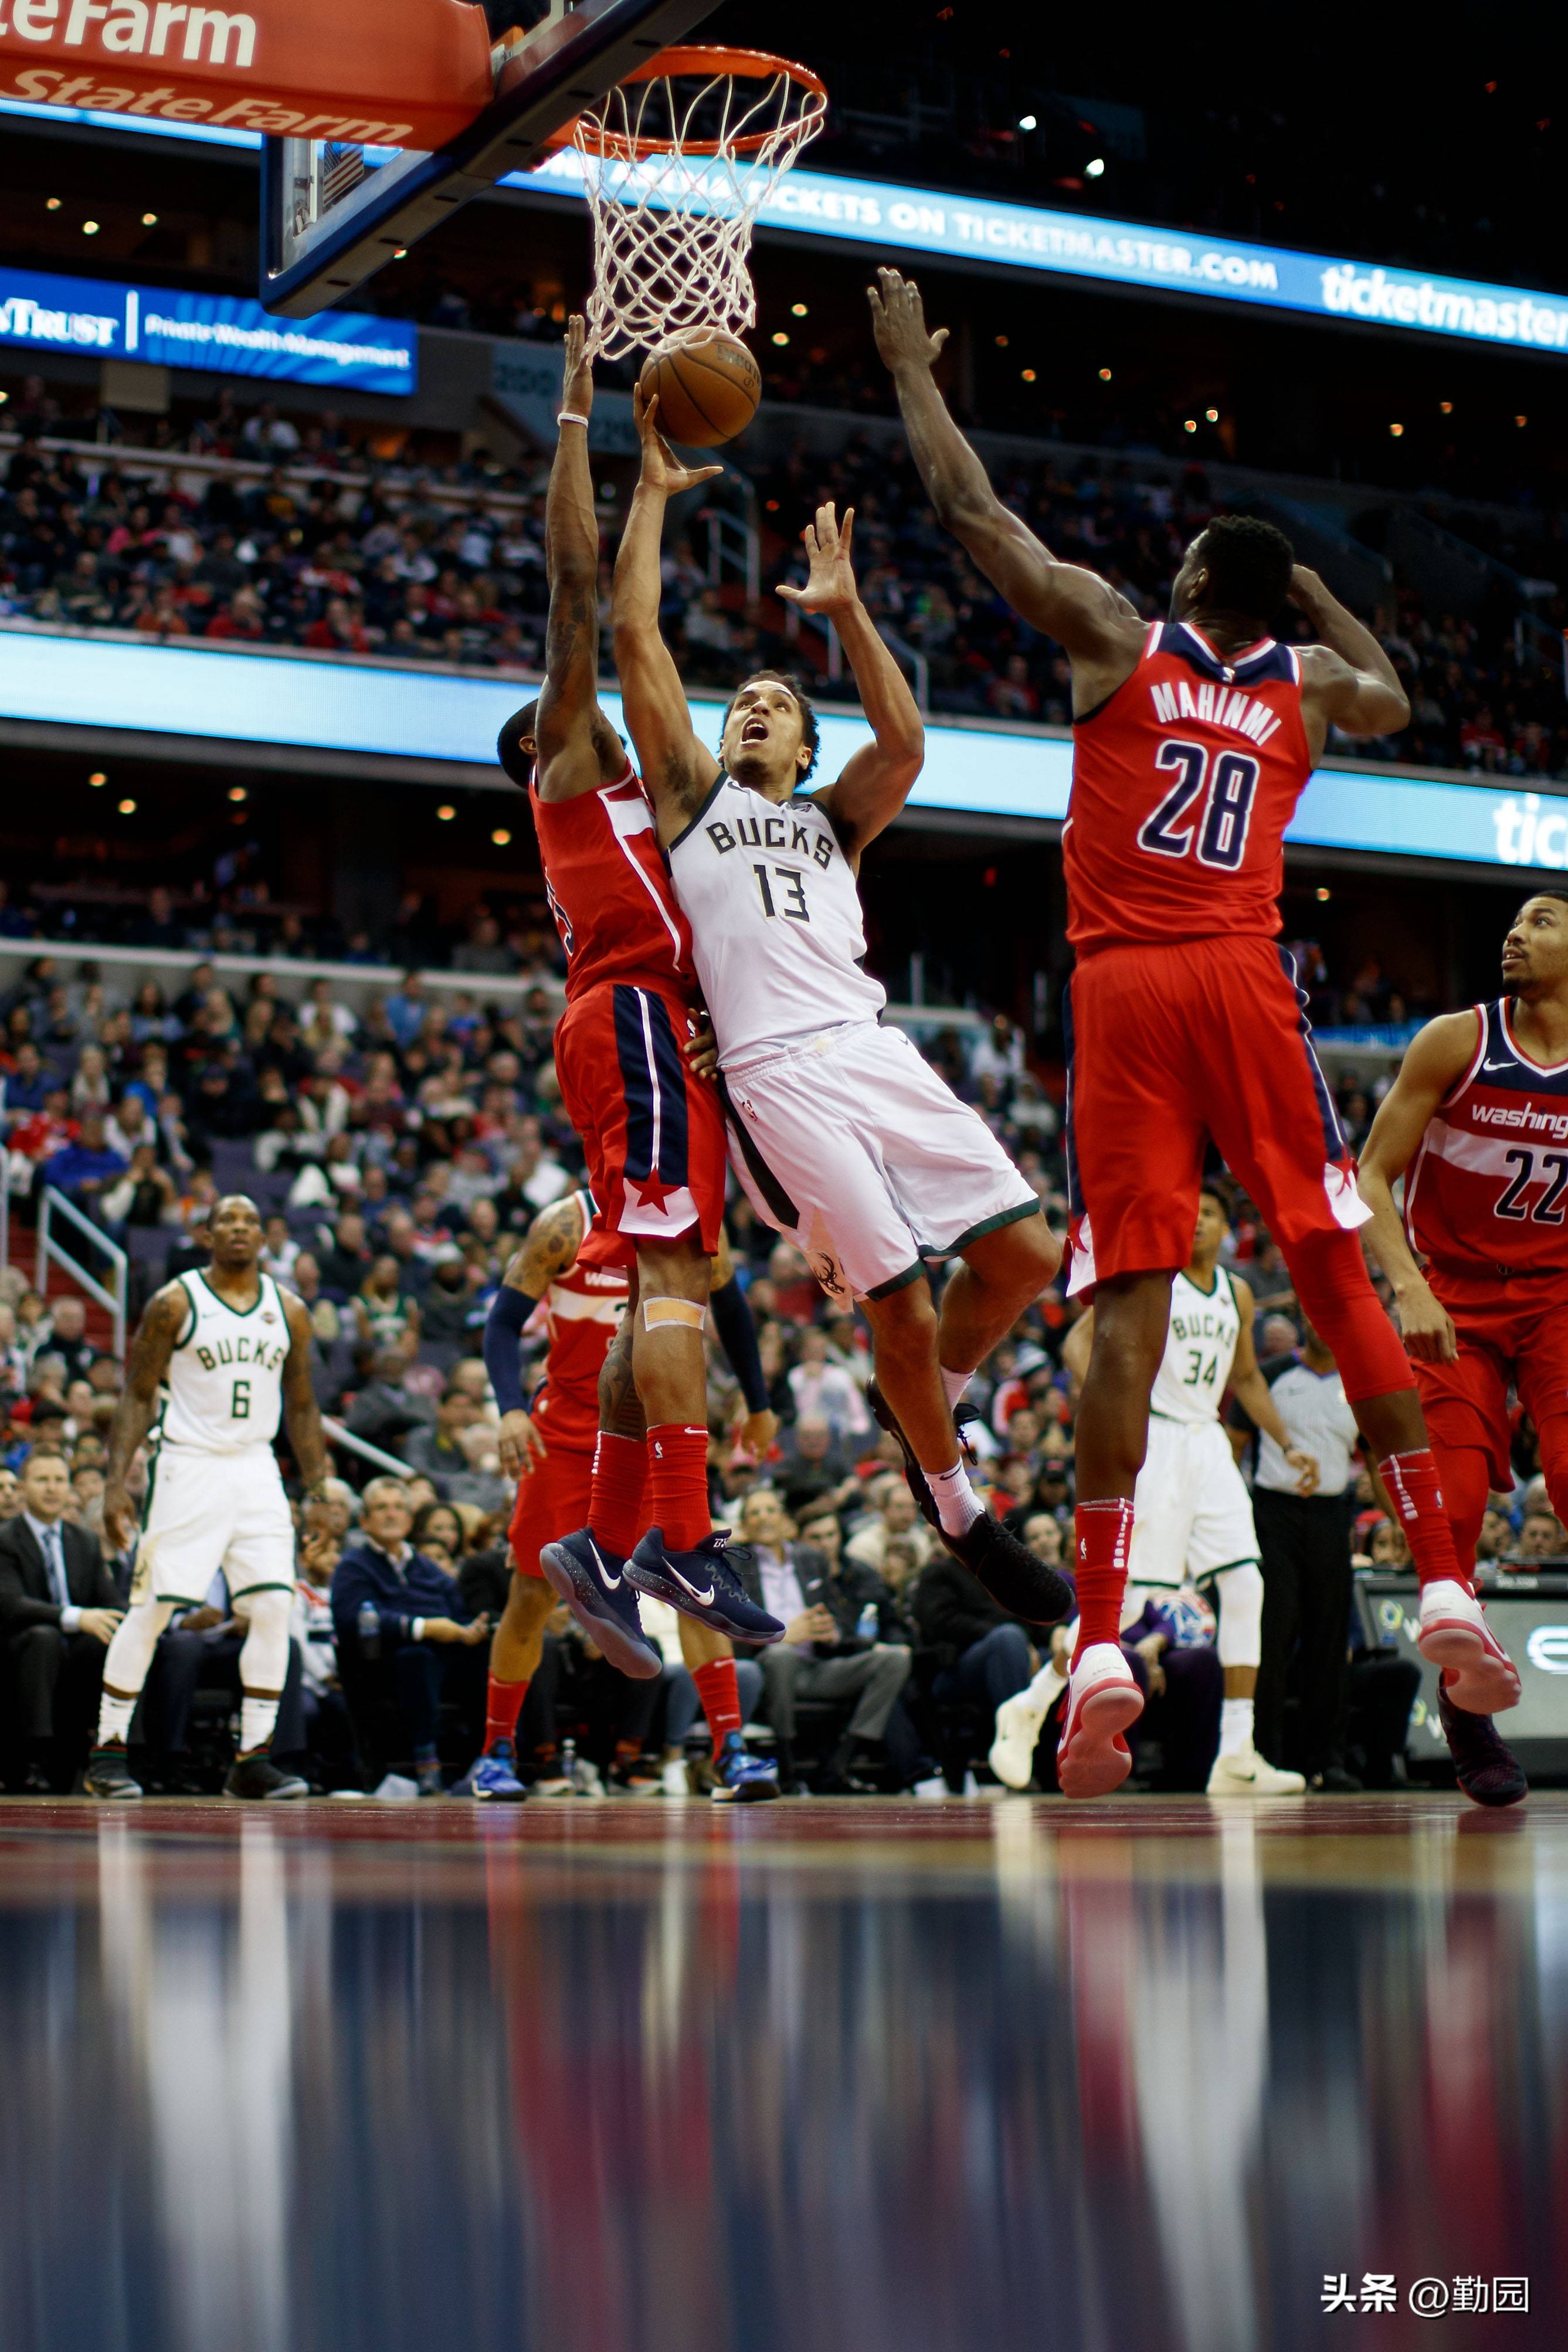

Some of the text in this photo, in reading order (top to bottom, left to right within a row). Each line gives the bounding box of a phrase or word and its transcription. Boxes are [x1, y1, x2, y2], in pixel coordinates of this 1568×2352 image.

[0, 69, 413, 142] State Farm
[888, 202, 946, 235] ON
[951, 211, 1279, 291] TICKETMASTER.COM
[1321, 264, 1568, 346] ticketmaster
[1150, 681, 1282, 746] MAHINMI
[1136, 739, 1260, 871] 28
[705, 817, 834, 872] BUCKS
[753, 864, 810, 923] 13
[1494, 1148, 1568, 1226] 22
[196, 1336, 285, 1371] BUCKS
[1172, 1314, 1235, 1349] BUCKS
[231, 1379, 252, 1418] 6
[1183, 1349, 1218, 1387] 34
